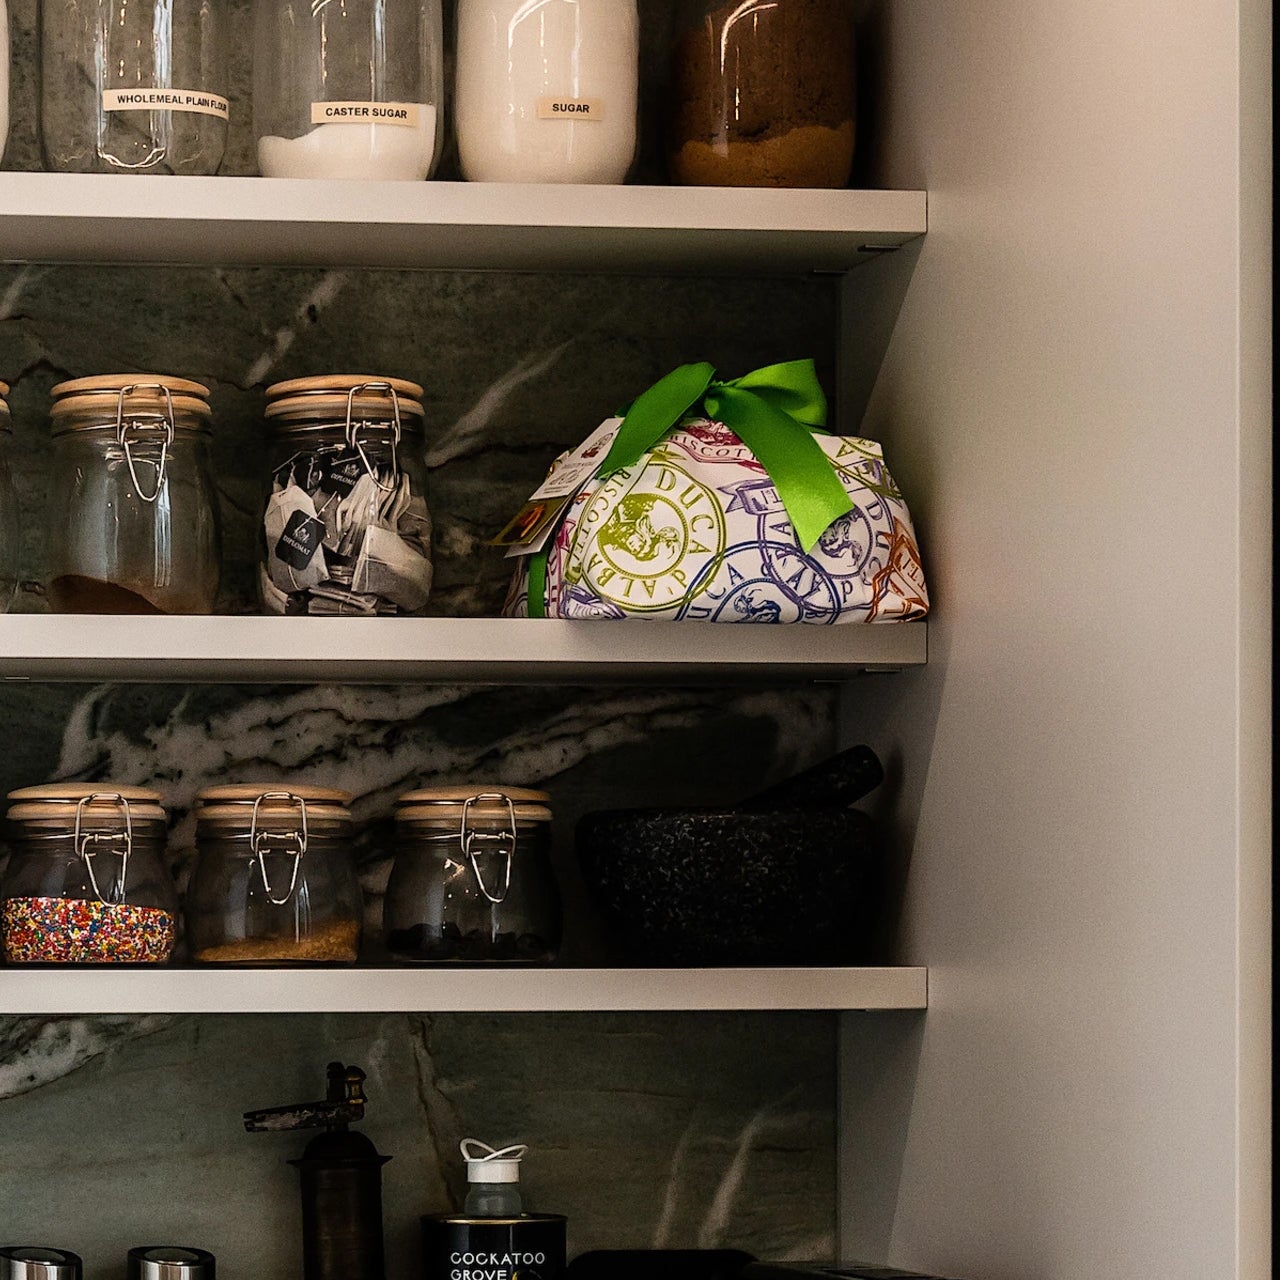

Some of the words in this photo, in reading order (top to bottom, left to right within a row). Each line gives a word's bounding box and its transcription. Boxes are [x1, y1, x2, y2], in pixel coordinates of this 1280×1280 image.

[117, 94, 184, 104] WHOLEMEAL
[186, 96, 210, 107] PLAIN
[210, 100, 227, 112] FLOUR
[552, 103, 590, 114] SUGAR
[325, 107, 369, 117] CASTER
[372, 108, 408, 119] SUGAR
[655, 467, 714, 555] DUCA
[282, 534, 311, 556] DIPLOMAT
[450, 1252, 545, 1265] COCKATOO
